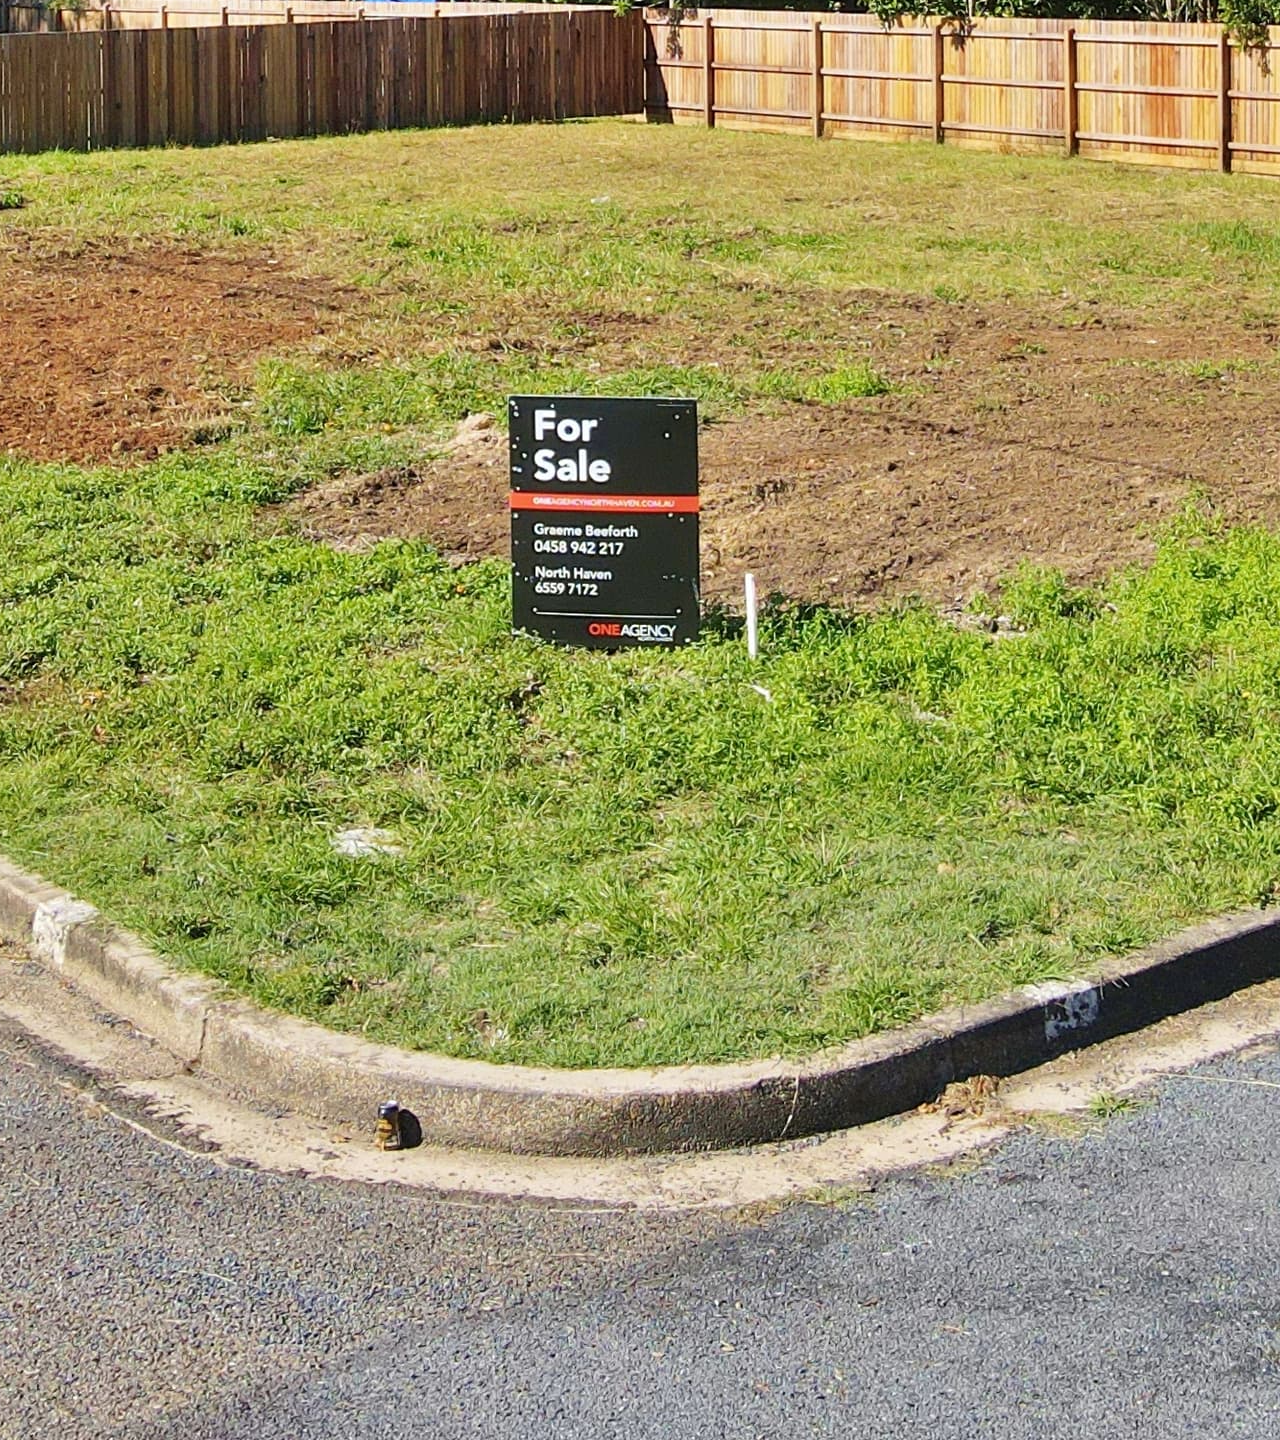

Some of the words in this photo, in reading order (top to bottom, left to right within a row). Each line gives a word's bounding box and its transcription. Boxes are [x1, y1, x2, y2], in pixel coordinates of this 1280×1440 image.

[534, 409, 598, 442] For
[533, 448, 611, 483] Sale
[533, 523, 582, 537] Graeme
[585, 524, 639, 538] Beeforth
[534, 540, 567, 553] 0458
[570, 541, 596, 554] 942
[599, 542, 624, 555] 217
[535, 566, 570, 579] North
[573, 567, 612, 580] Haven
[535, 582, 565, 594] 6559
[568, 583, 598, 596] 7172
